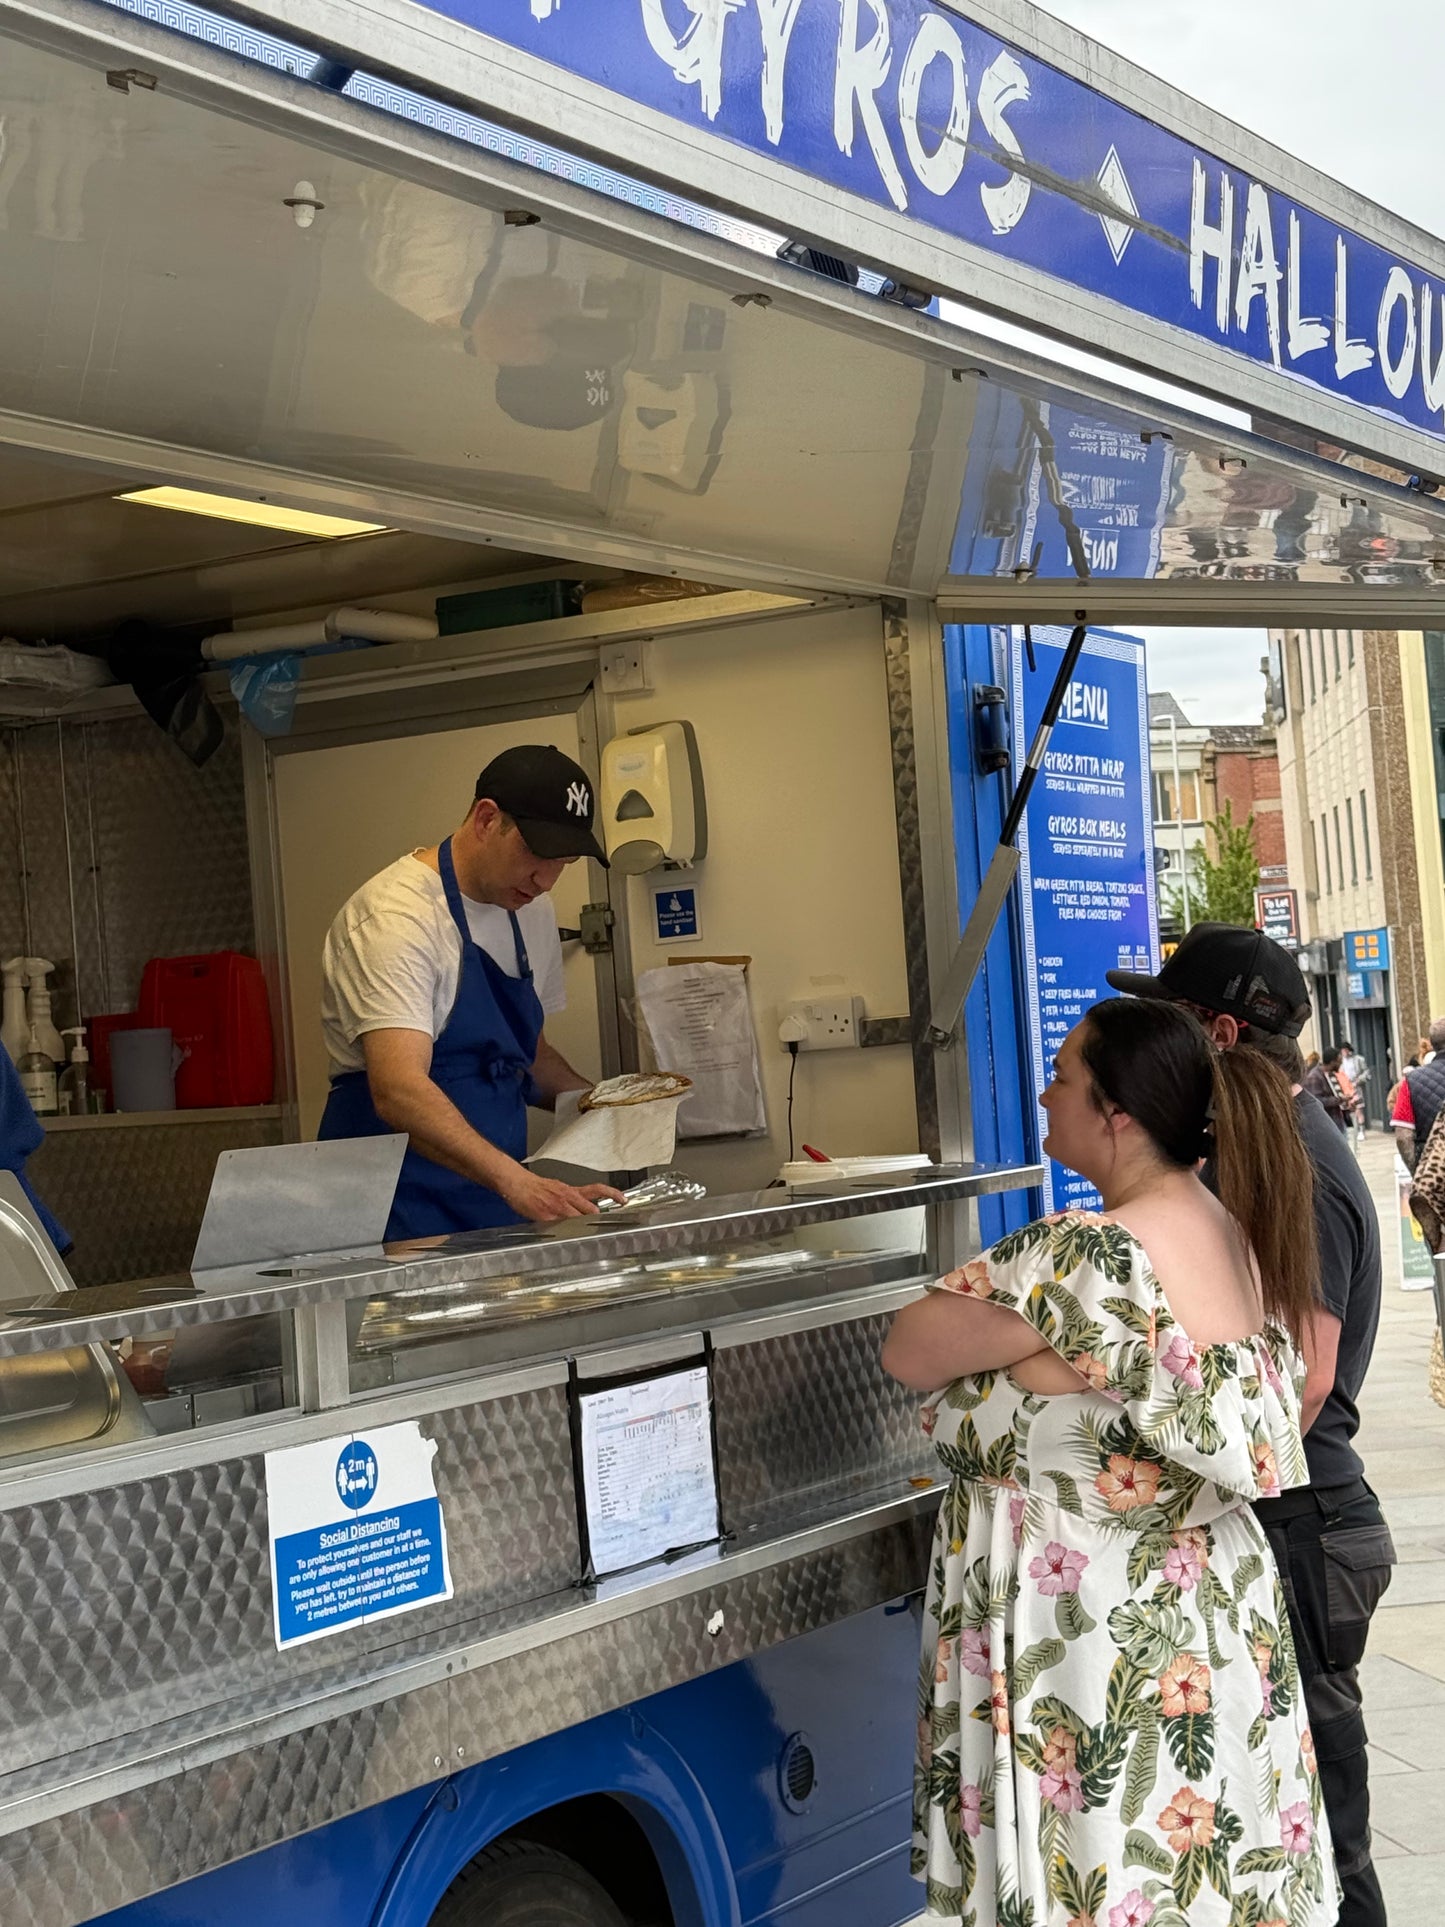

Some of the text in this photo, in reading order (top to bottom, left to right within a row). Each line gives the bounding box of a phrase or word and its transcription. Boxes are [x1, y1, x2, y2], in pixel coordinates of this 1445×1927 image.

[641, 0, 1031, 235] GYROS
[1058, 681, 1109, 726] MENU
[1044, 751, 1125, 779] GYROS PITTA WRAP
[1066, 781, 1076, 792] ALL
[1077, 782, 1099, 794] WRAPPED
[1048, 815, 1126, 840] GYROS BOX MEALS
[1113, 848, 1124, 858] BOX
[1034, 877, 1050, 890] WARM
[1051, 879, 1069, 891] GREEK
[1069, 880, 1085, 892] PITTA
[1080, 894, 1090, 906] RED
[1263, 898, 1289, 909] To Let
[1058, 908, 1074, 920] FRIES
[1075, 908, 1086, 920] AND
[1087, 908, 1107, 920] CHOOSE
[1108, 909, 1122, 921] FROM
[1042, 957, 1063, 967] CHICKEN
[1043, 973, 1057, 984] PORK
[1045, 989, 1058, 1000] DEEP
[1058, 989, 1072, 1000] FRIED
[348, 1459, 365, 1473] 2m
[320, 1516, 400, 1547] Social Distancing
[296, 1528, 423, 1570] To protect yourselves and our staff we
[289, 1574, 301, 1584] are
[302, 1569, 318, 1581] only
[318, 1562, 346, 1576] allowing
[346, 1557, 360, 1568] one
[361, 1548, 393, 1564] customer
[393, 1545, 400, 1554] in
[401, 1543, 409, 1553] at
[414, 1538, 432, 1548] time.
[290, 1554, 431, 1601] Please wait outside until the person before
[295, 1601, 309, 1615] you
[309, 1597, 323, 1608] has
[337, 1590, 348, 1600] try
[348, 1587, 356, 1596] to
[356, 1578, 387, 1593] maintain
[392, 1569, 421, 1582] distance
[421, 1564, 429, 1575] of
[307, 1581, 419, 1621] 2 metres between you and others.
